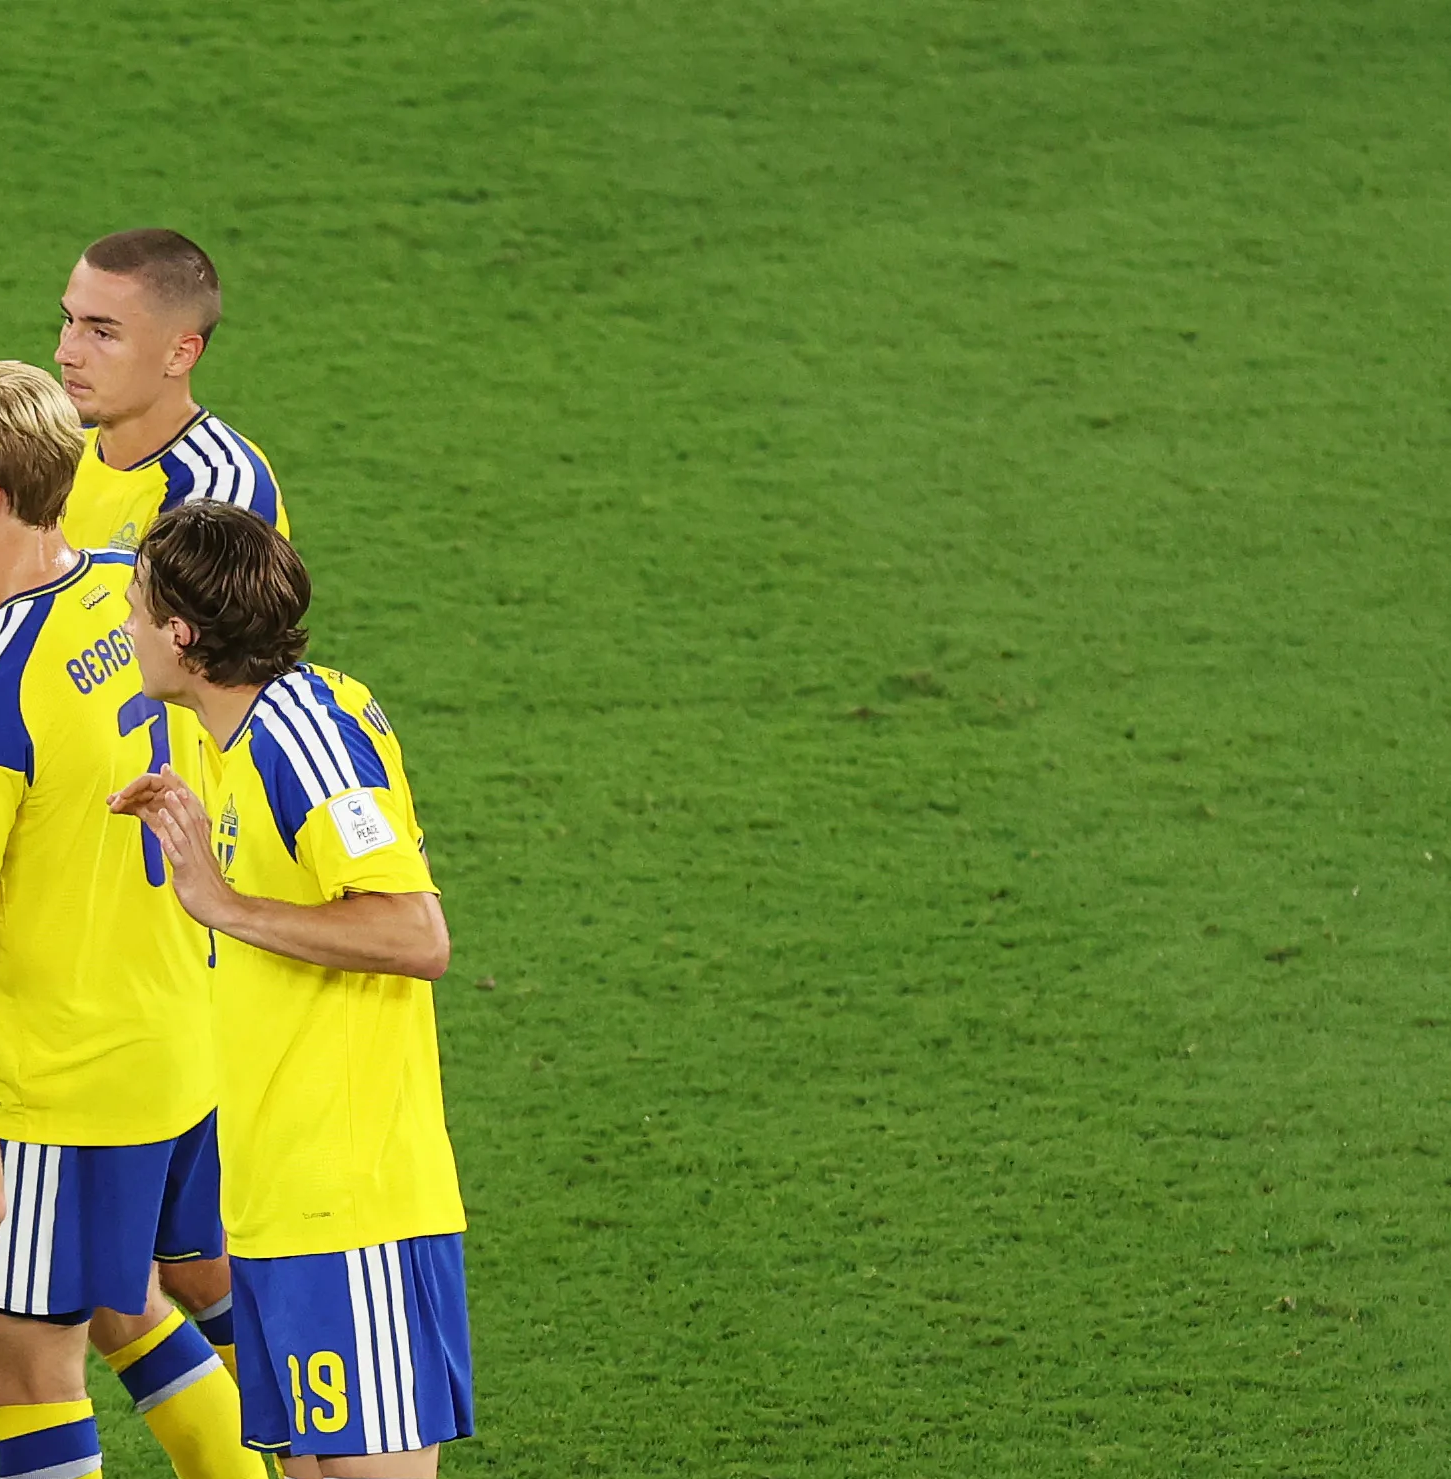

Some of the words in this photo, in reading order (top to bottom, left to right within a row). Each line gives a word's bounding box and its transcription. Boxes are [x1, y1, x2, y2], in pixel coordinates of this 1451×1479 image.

[117, 689, 171, 888] 7
[356, 824, 379, 840] PEACE
[287, 1350, 349, 1435] 19
